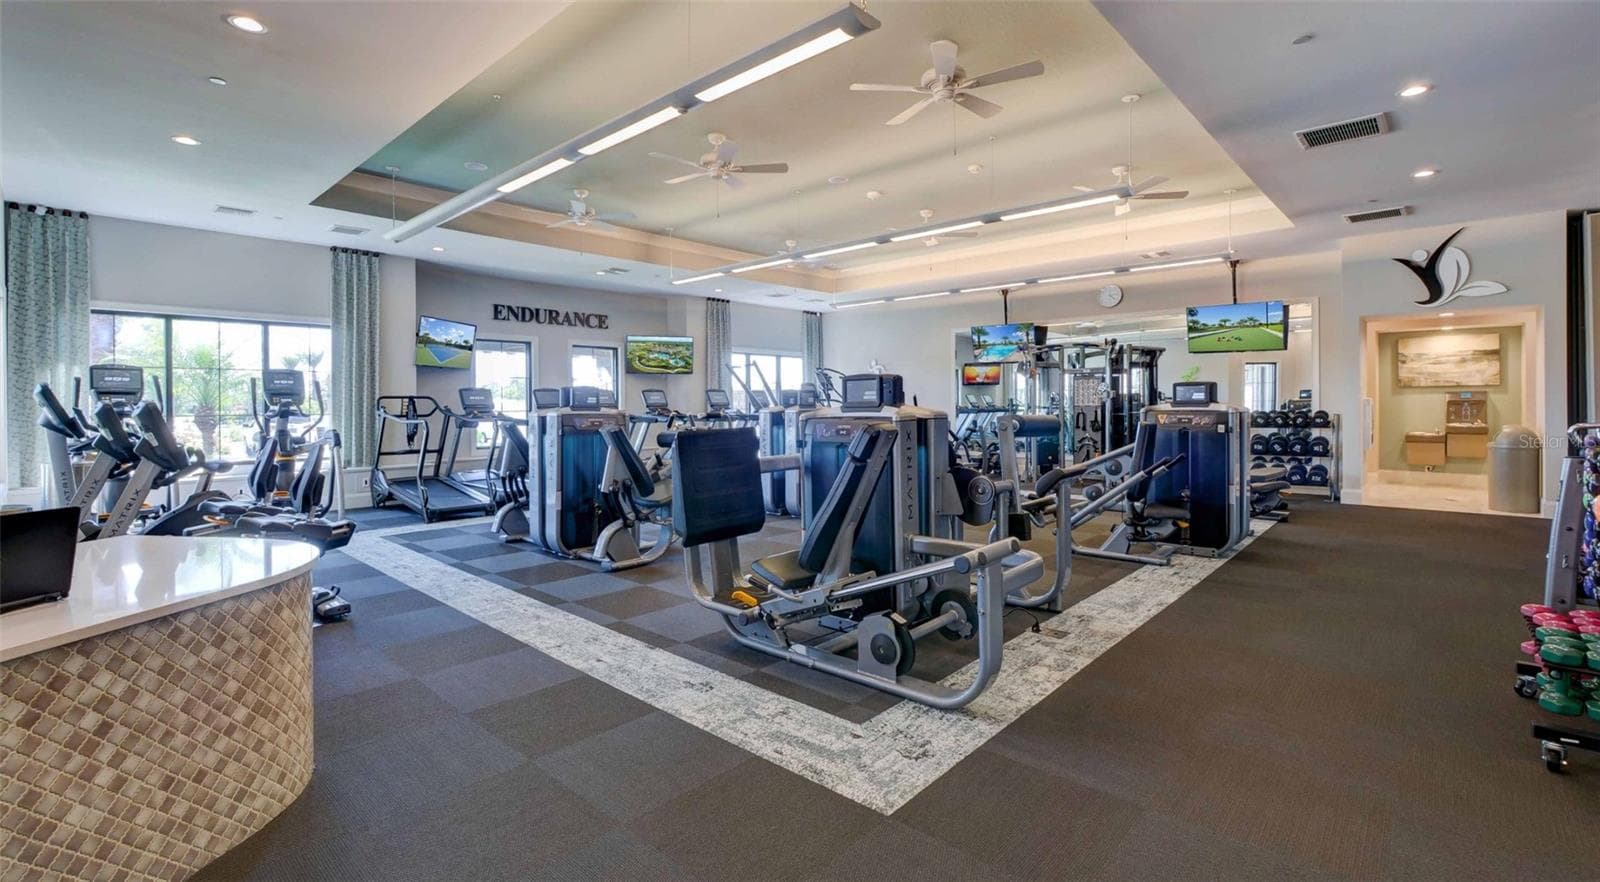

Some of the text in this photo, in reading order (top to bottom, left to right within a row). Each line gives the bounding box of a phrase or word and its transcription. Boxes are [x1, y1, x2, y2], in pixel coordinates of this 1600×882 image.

[492, 303, 609, 329] ENDURANCE
[60, 471, 72, 506] ATRIX
[905, 429, 915, 520] MATRIX
